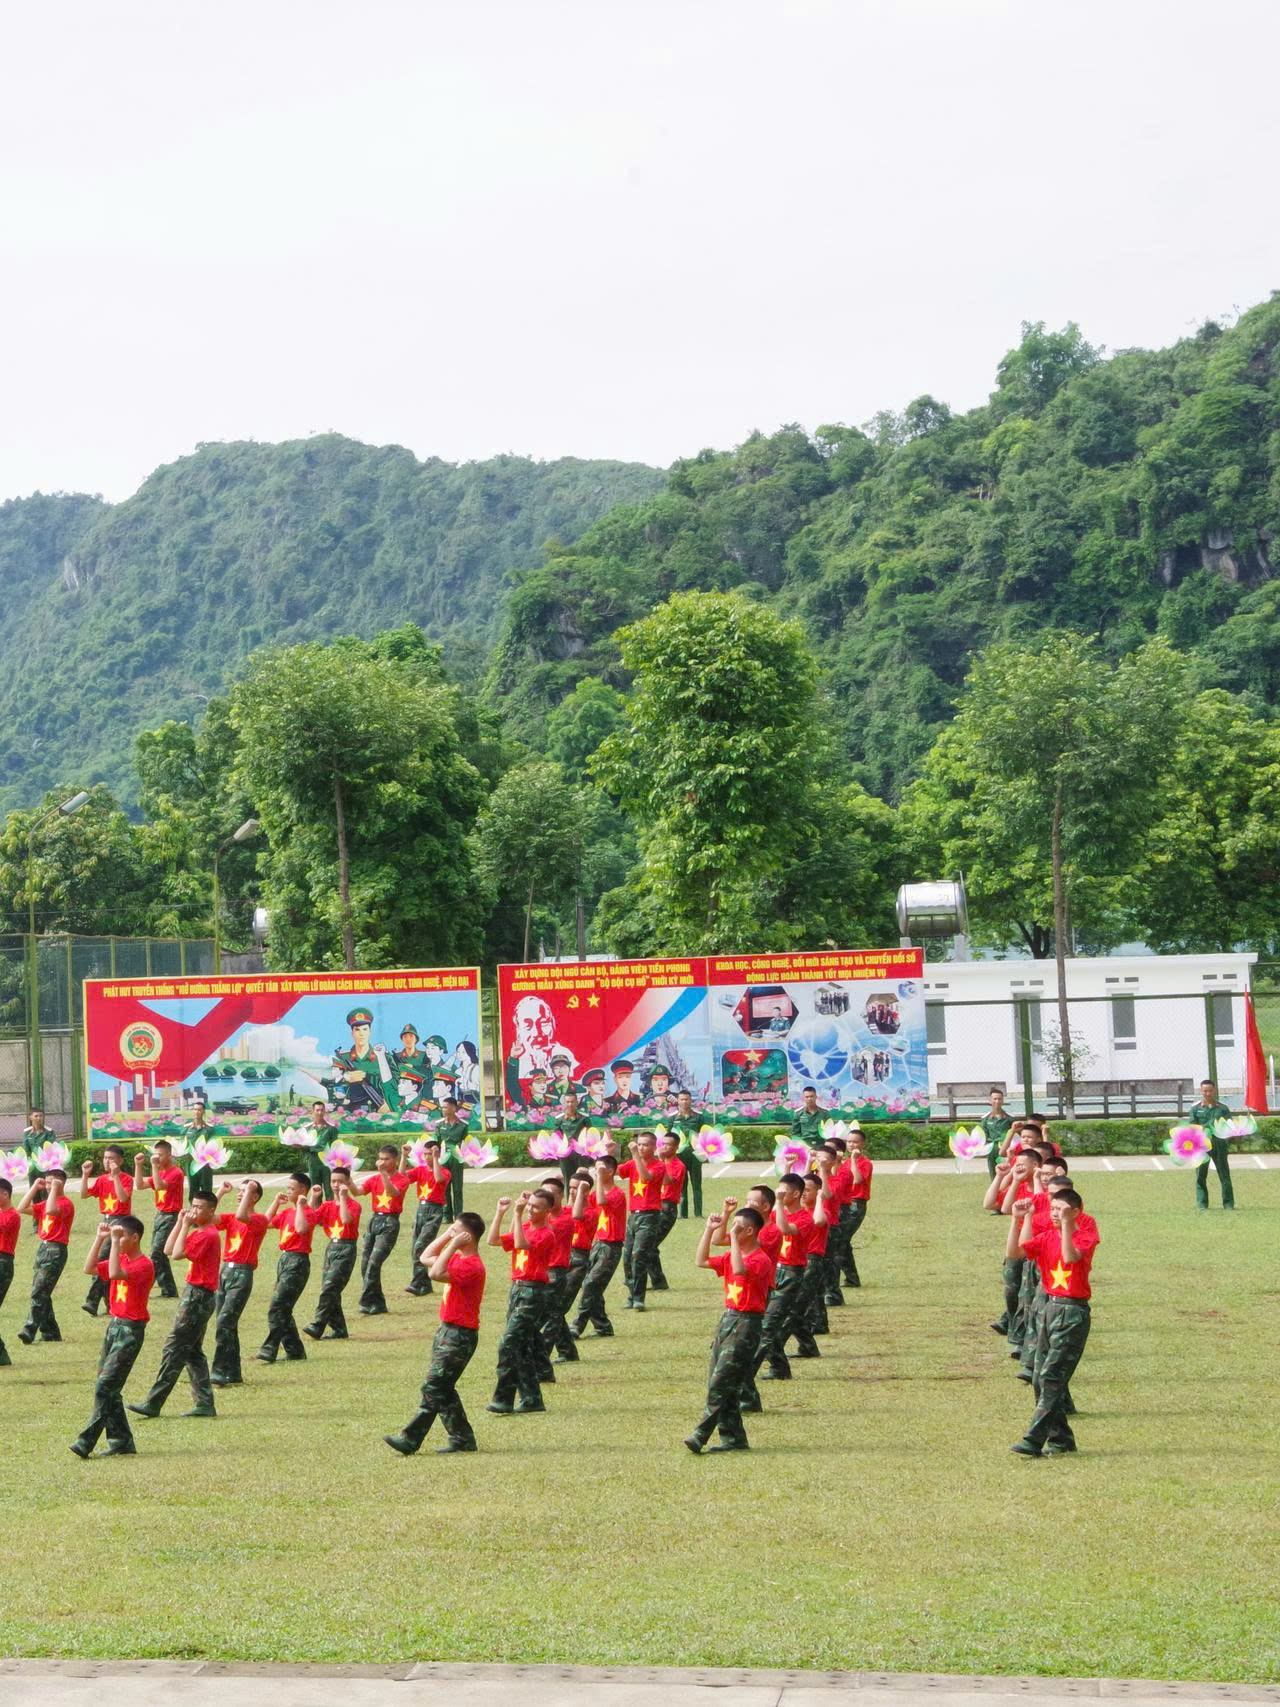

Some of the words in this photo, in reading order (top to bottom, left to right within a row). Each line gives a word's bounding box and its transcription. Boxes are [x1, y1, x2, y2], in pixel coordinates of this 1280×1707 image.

[716, 962, 734, 971] KHOA
[752, 959, 770, 969] CÔNG
[821, 956, 838, 966] SÁNG
[841, 957, 853, 967] TẠO
[855, 954, 863, 965] VÀ
[906, 951, 916, 963] SỐ
[515, 968, 528, 979] XÂY
[631, 963, 647, 974] VIÊN
[825, 968, 836, 978] TỐT
[877, 969, 886, 978] VỤ
[104, 985, 118, 998] PHÁT
[280, 980, 291, 992] XÂY
[337, 978, 353, 990] CÁCH
